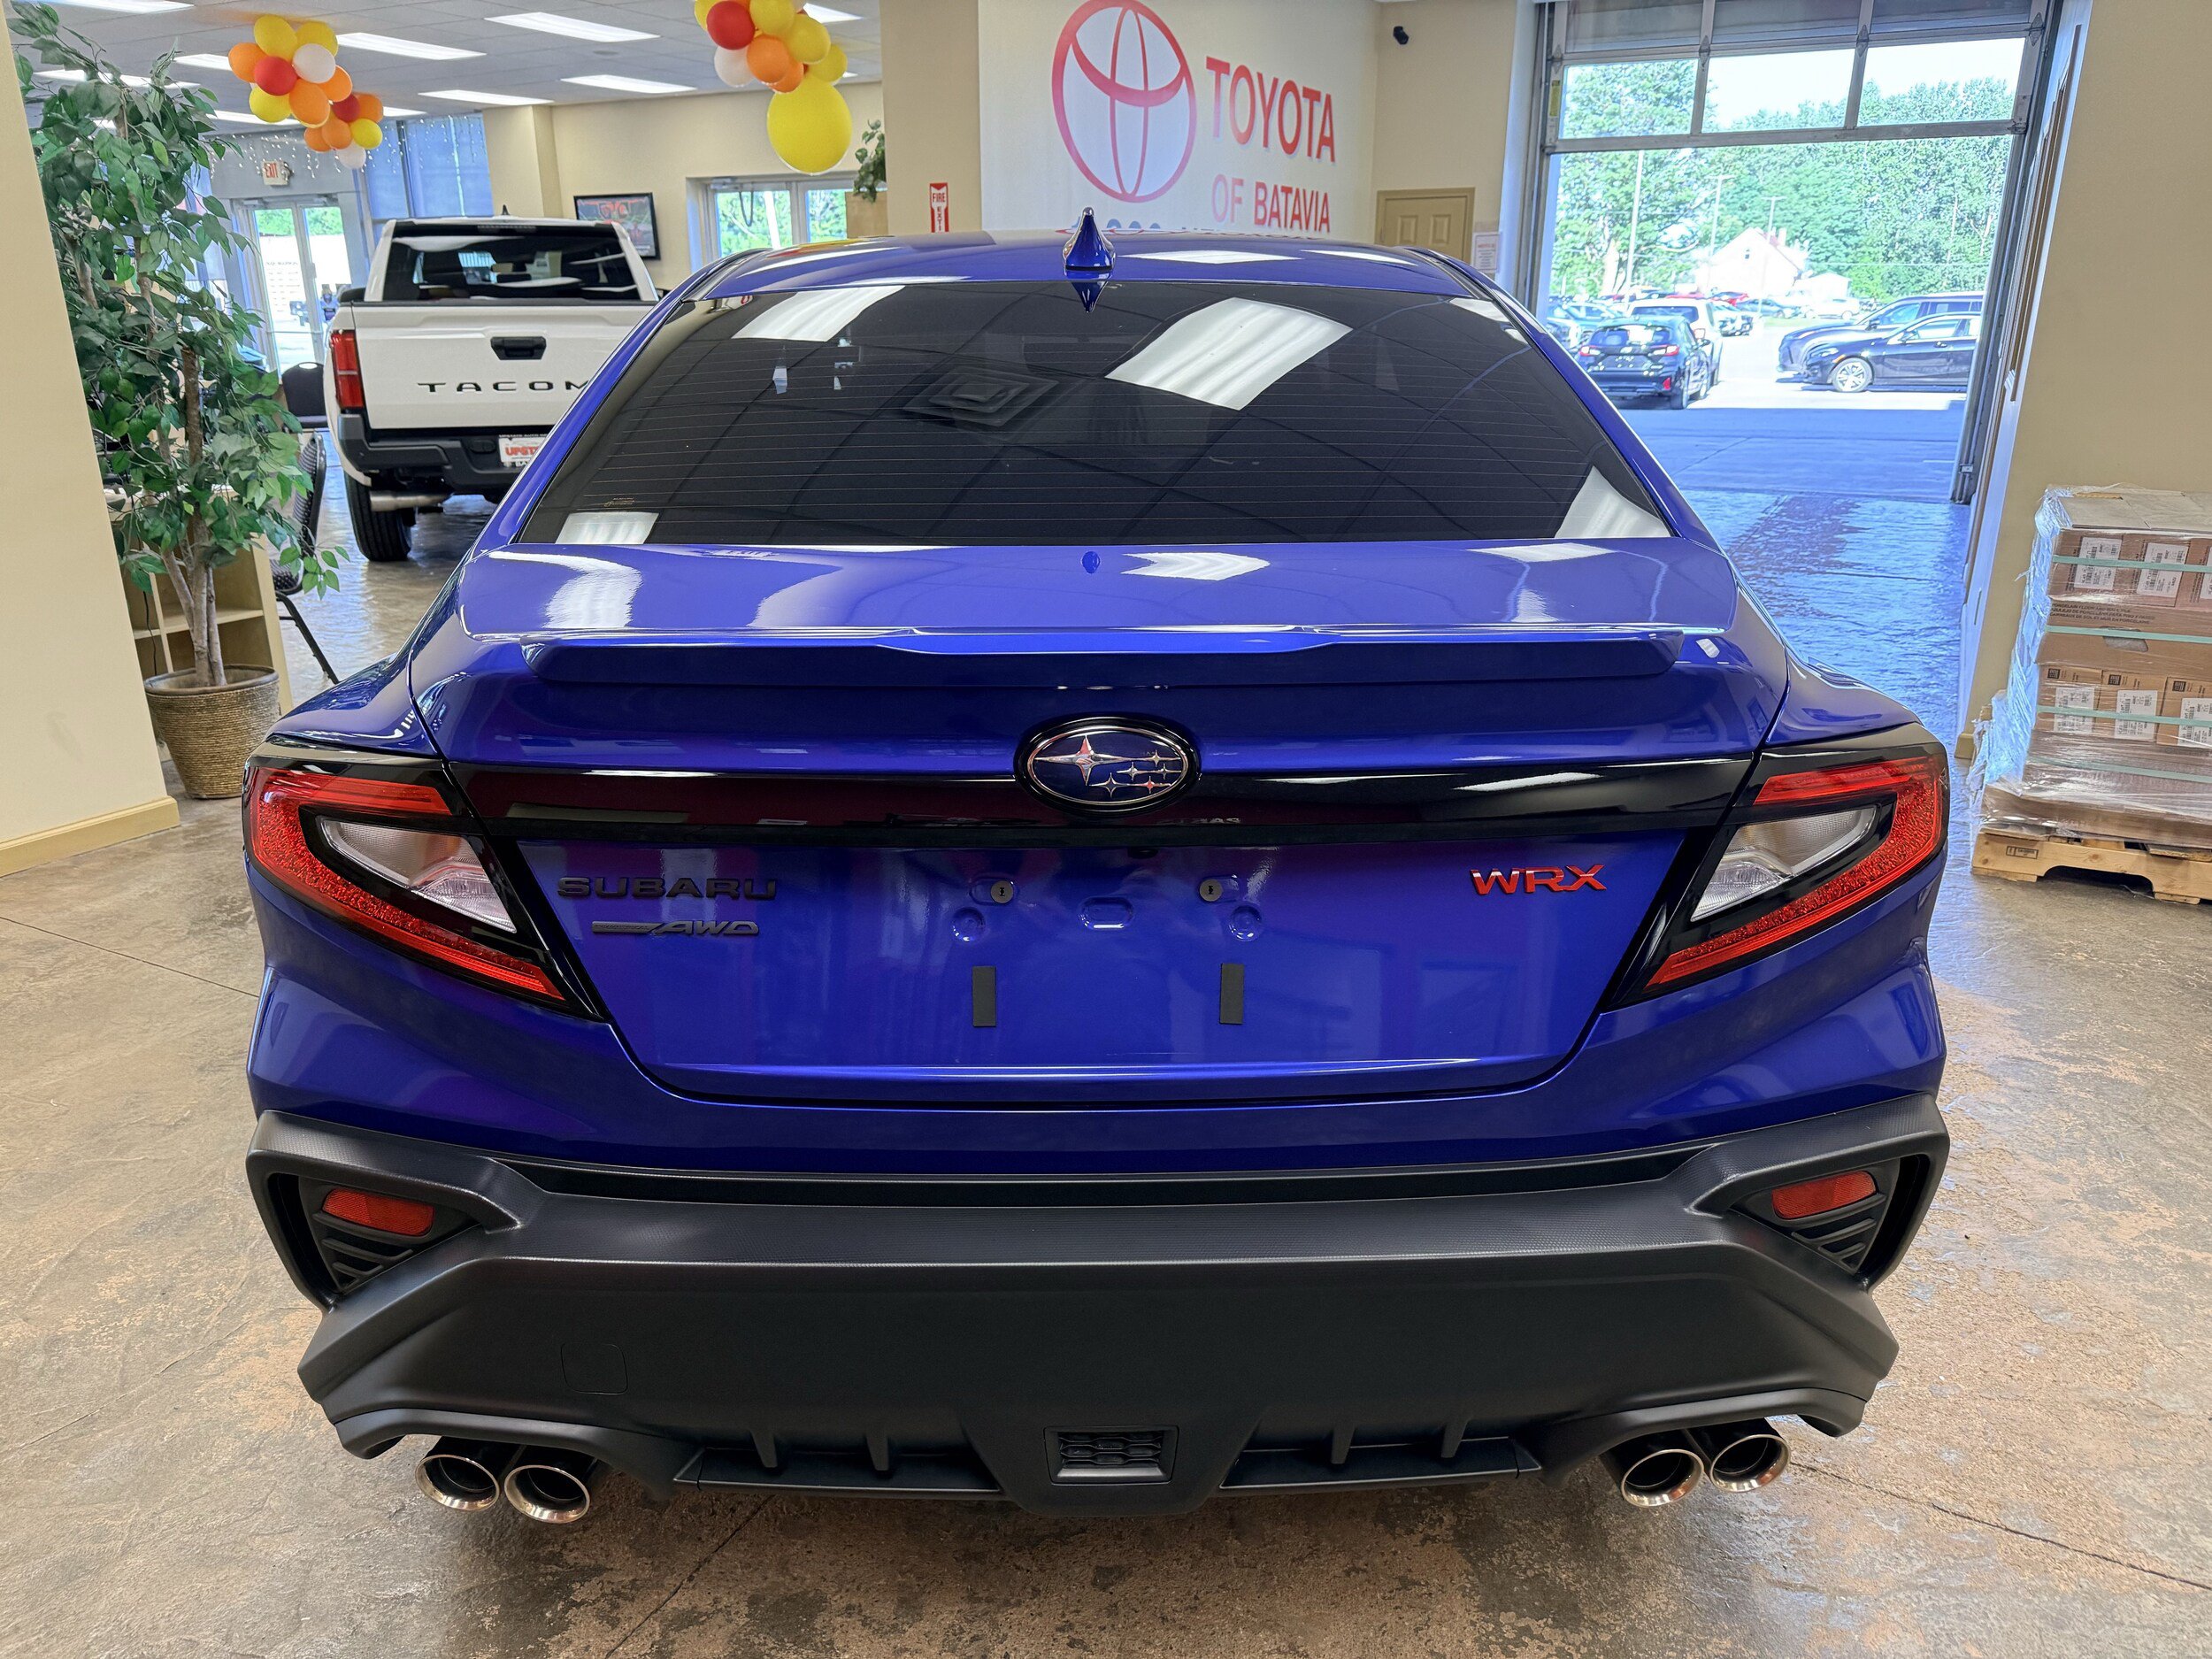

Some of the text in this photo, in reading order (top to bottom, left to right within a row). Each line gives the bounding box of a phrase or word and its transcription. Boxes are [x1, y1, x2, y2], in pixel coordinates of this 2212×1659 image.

[1206, 56, 1335, 163] TOYOTA
[264, 163, 278, 178] EXIT
[932, 192, 946, 203] FIRE
[1211, 173, 1330, 233] OF BATAVIA
[418, 380, 589, 393] TACOM
[557, 877, 777, 899] SUBARU
[1471, 864, 1607, 895] WRX
[653, 920, 759, 935] AWD
